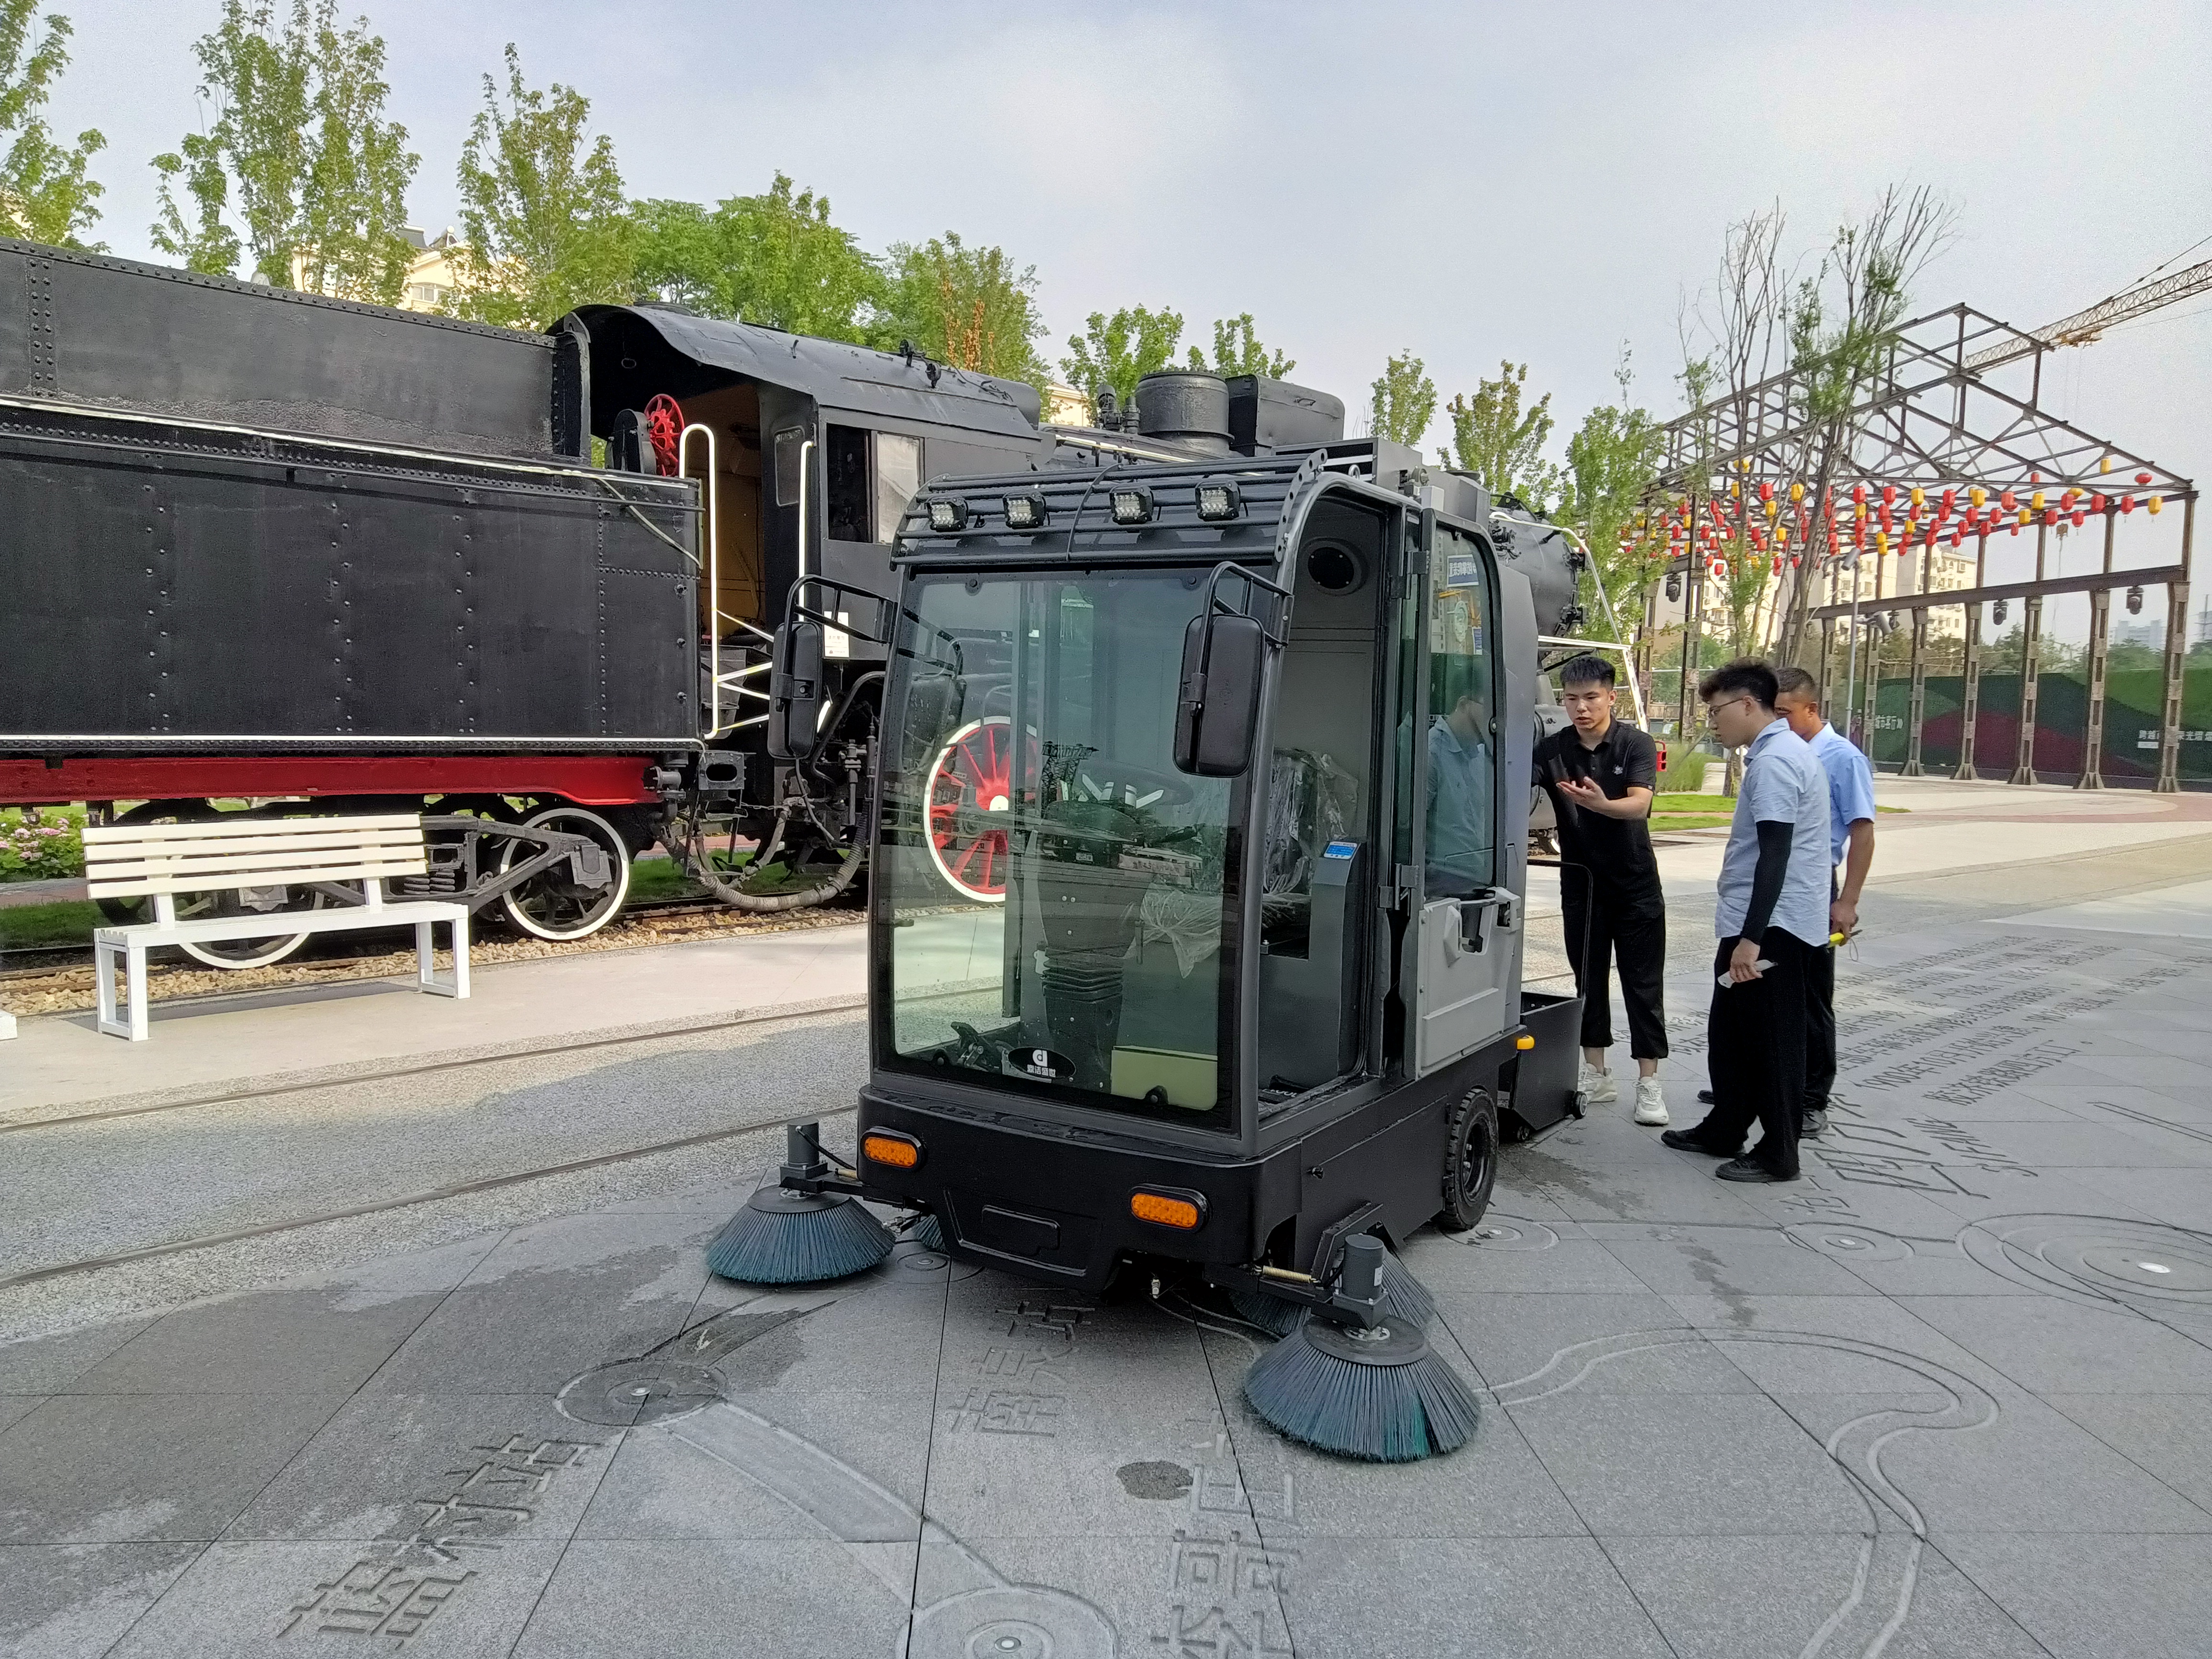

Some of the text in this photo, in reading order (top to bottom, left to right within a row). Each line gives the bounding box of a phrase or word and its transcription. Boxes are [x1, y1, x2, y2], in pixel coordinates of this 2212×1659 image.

[1902, 1118, 2038, 1177] SIFANG
[948, 1300, 1095, 1437] 南泉站
[277, 1434, 601, 1649] 蓝村站
